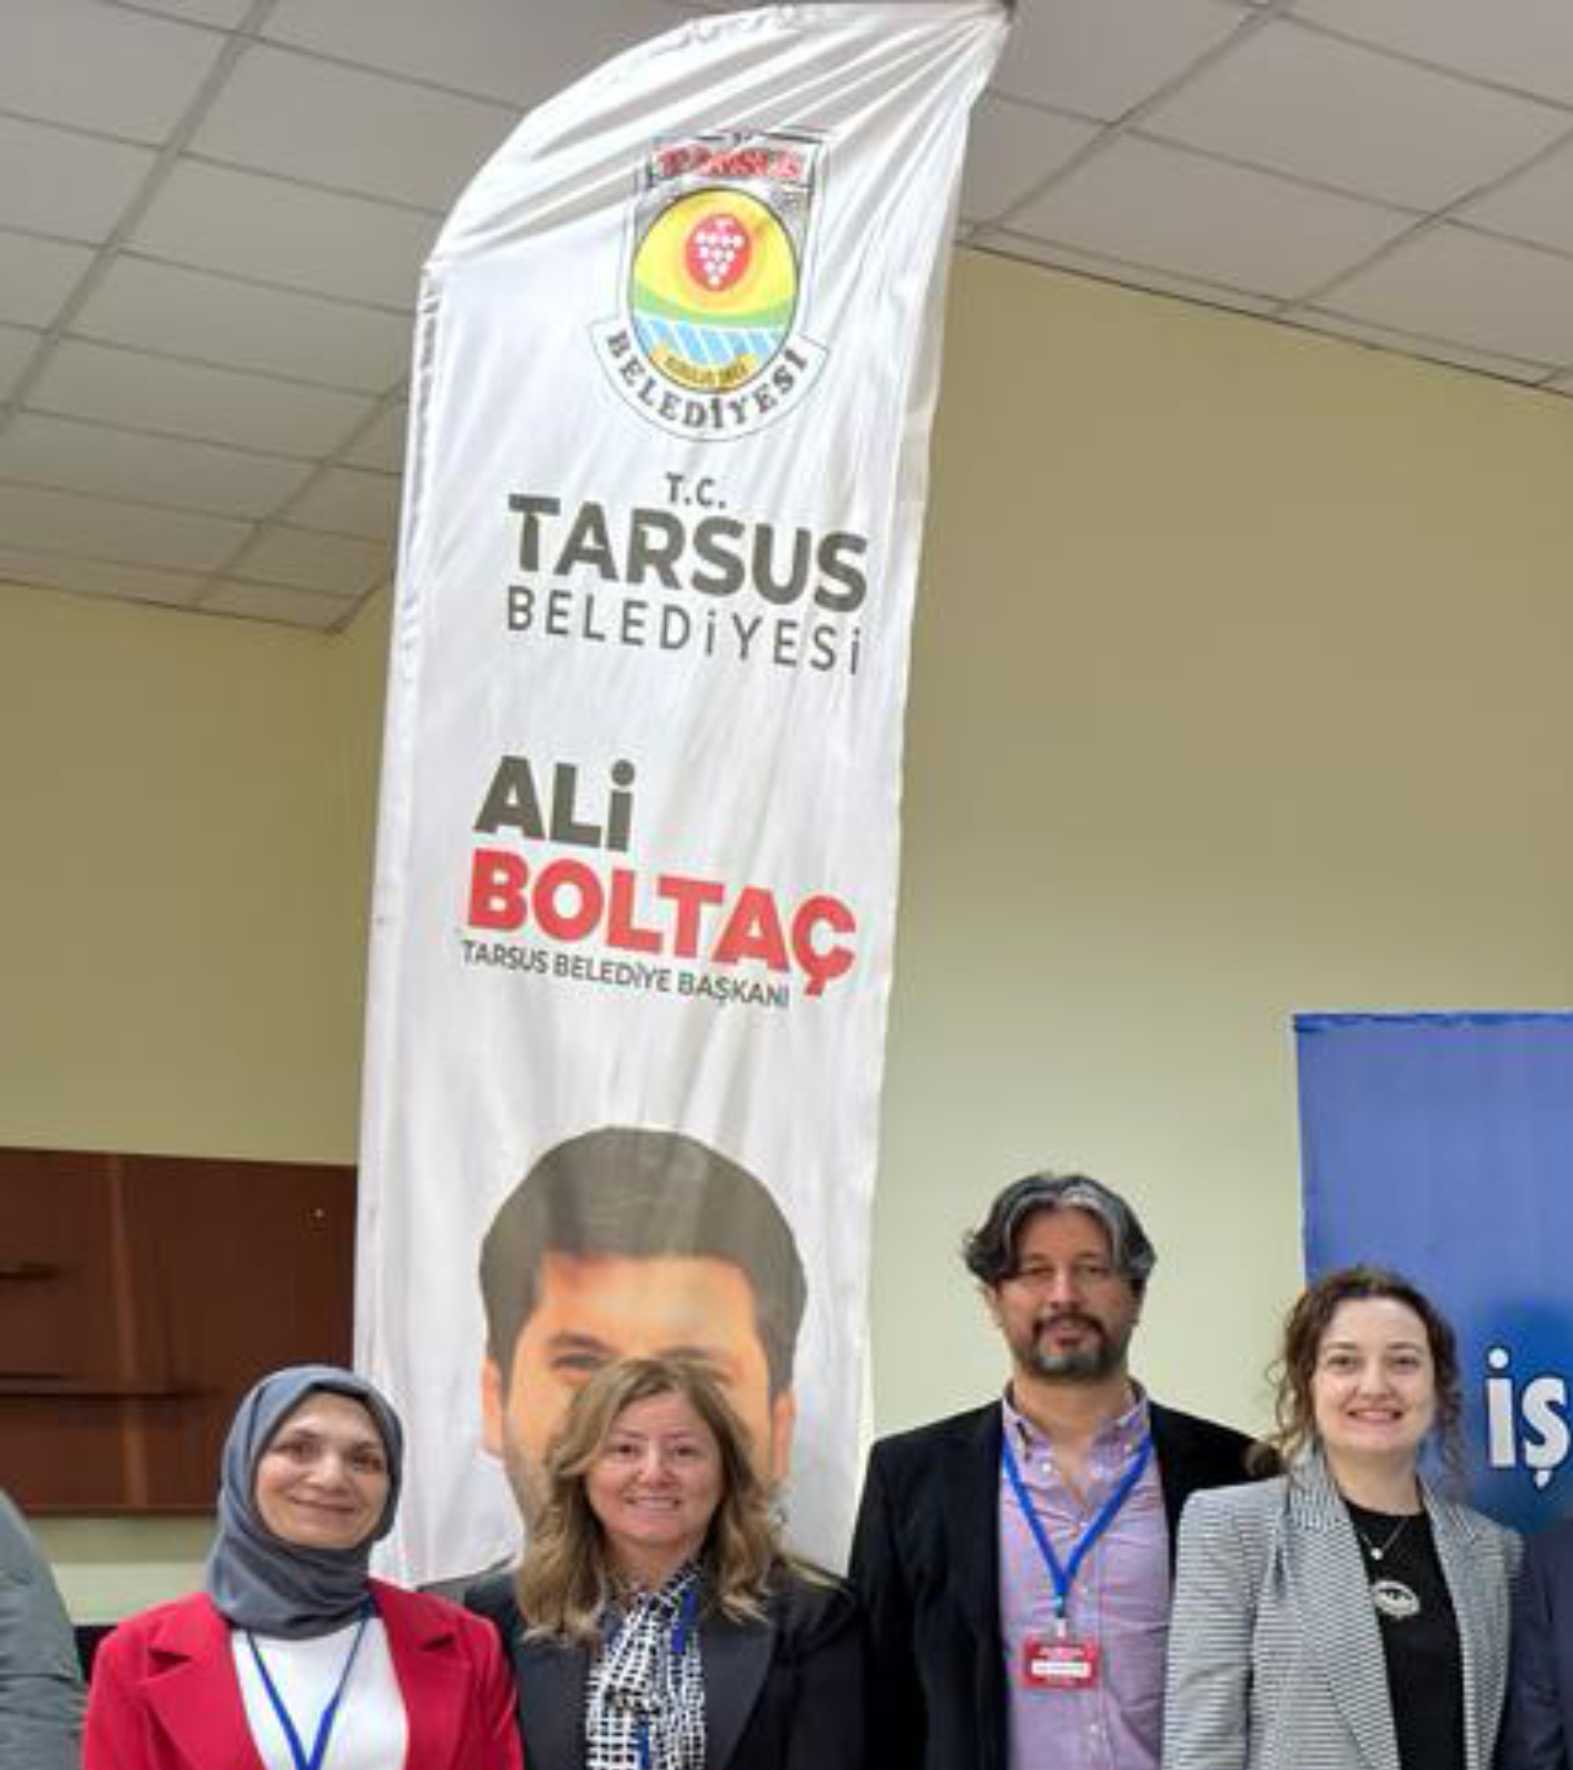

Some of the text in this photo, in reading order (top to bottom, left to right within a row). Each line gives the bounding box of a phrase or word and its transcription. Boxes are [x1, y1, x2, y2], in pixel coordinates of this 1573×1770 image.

[666, 472, 727, 509] T.C.
[508, 493, 868, 613] TARSUS
[507, 585, 861, 675] BELEDİYESİ
[473, 755, 635, 852] ALİ
[467, 848, 856, 996] BOLTAÇ
[461, 939, 790, 1008] TARSUS BELEDİYE BAŞKANI
[1488, 1348, 1570, 1488] İŞ
